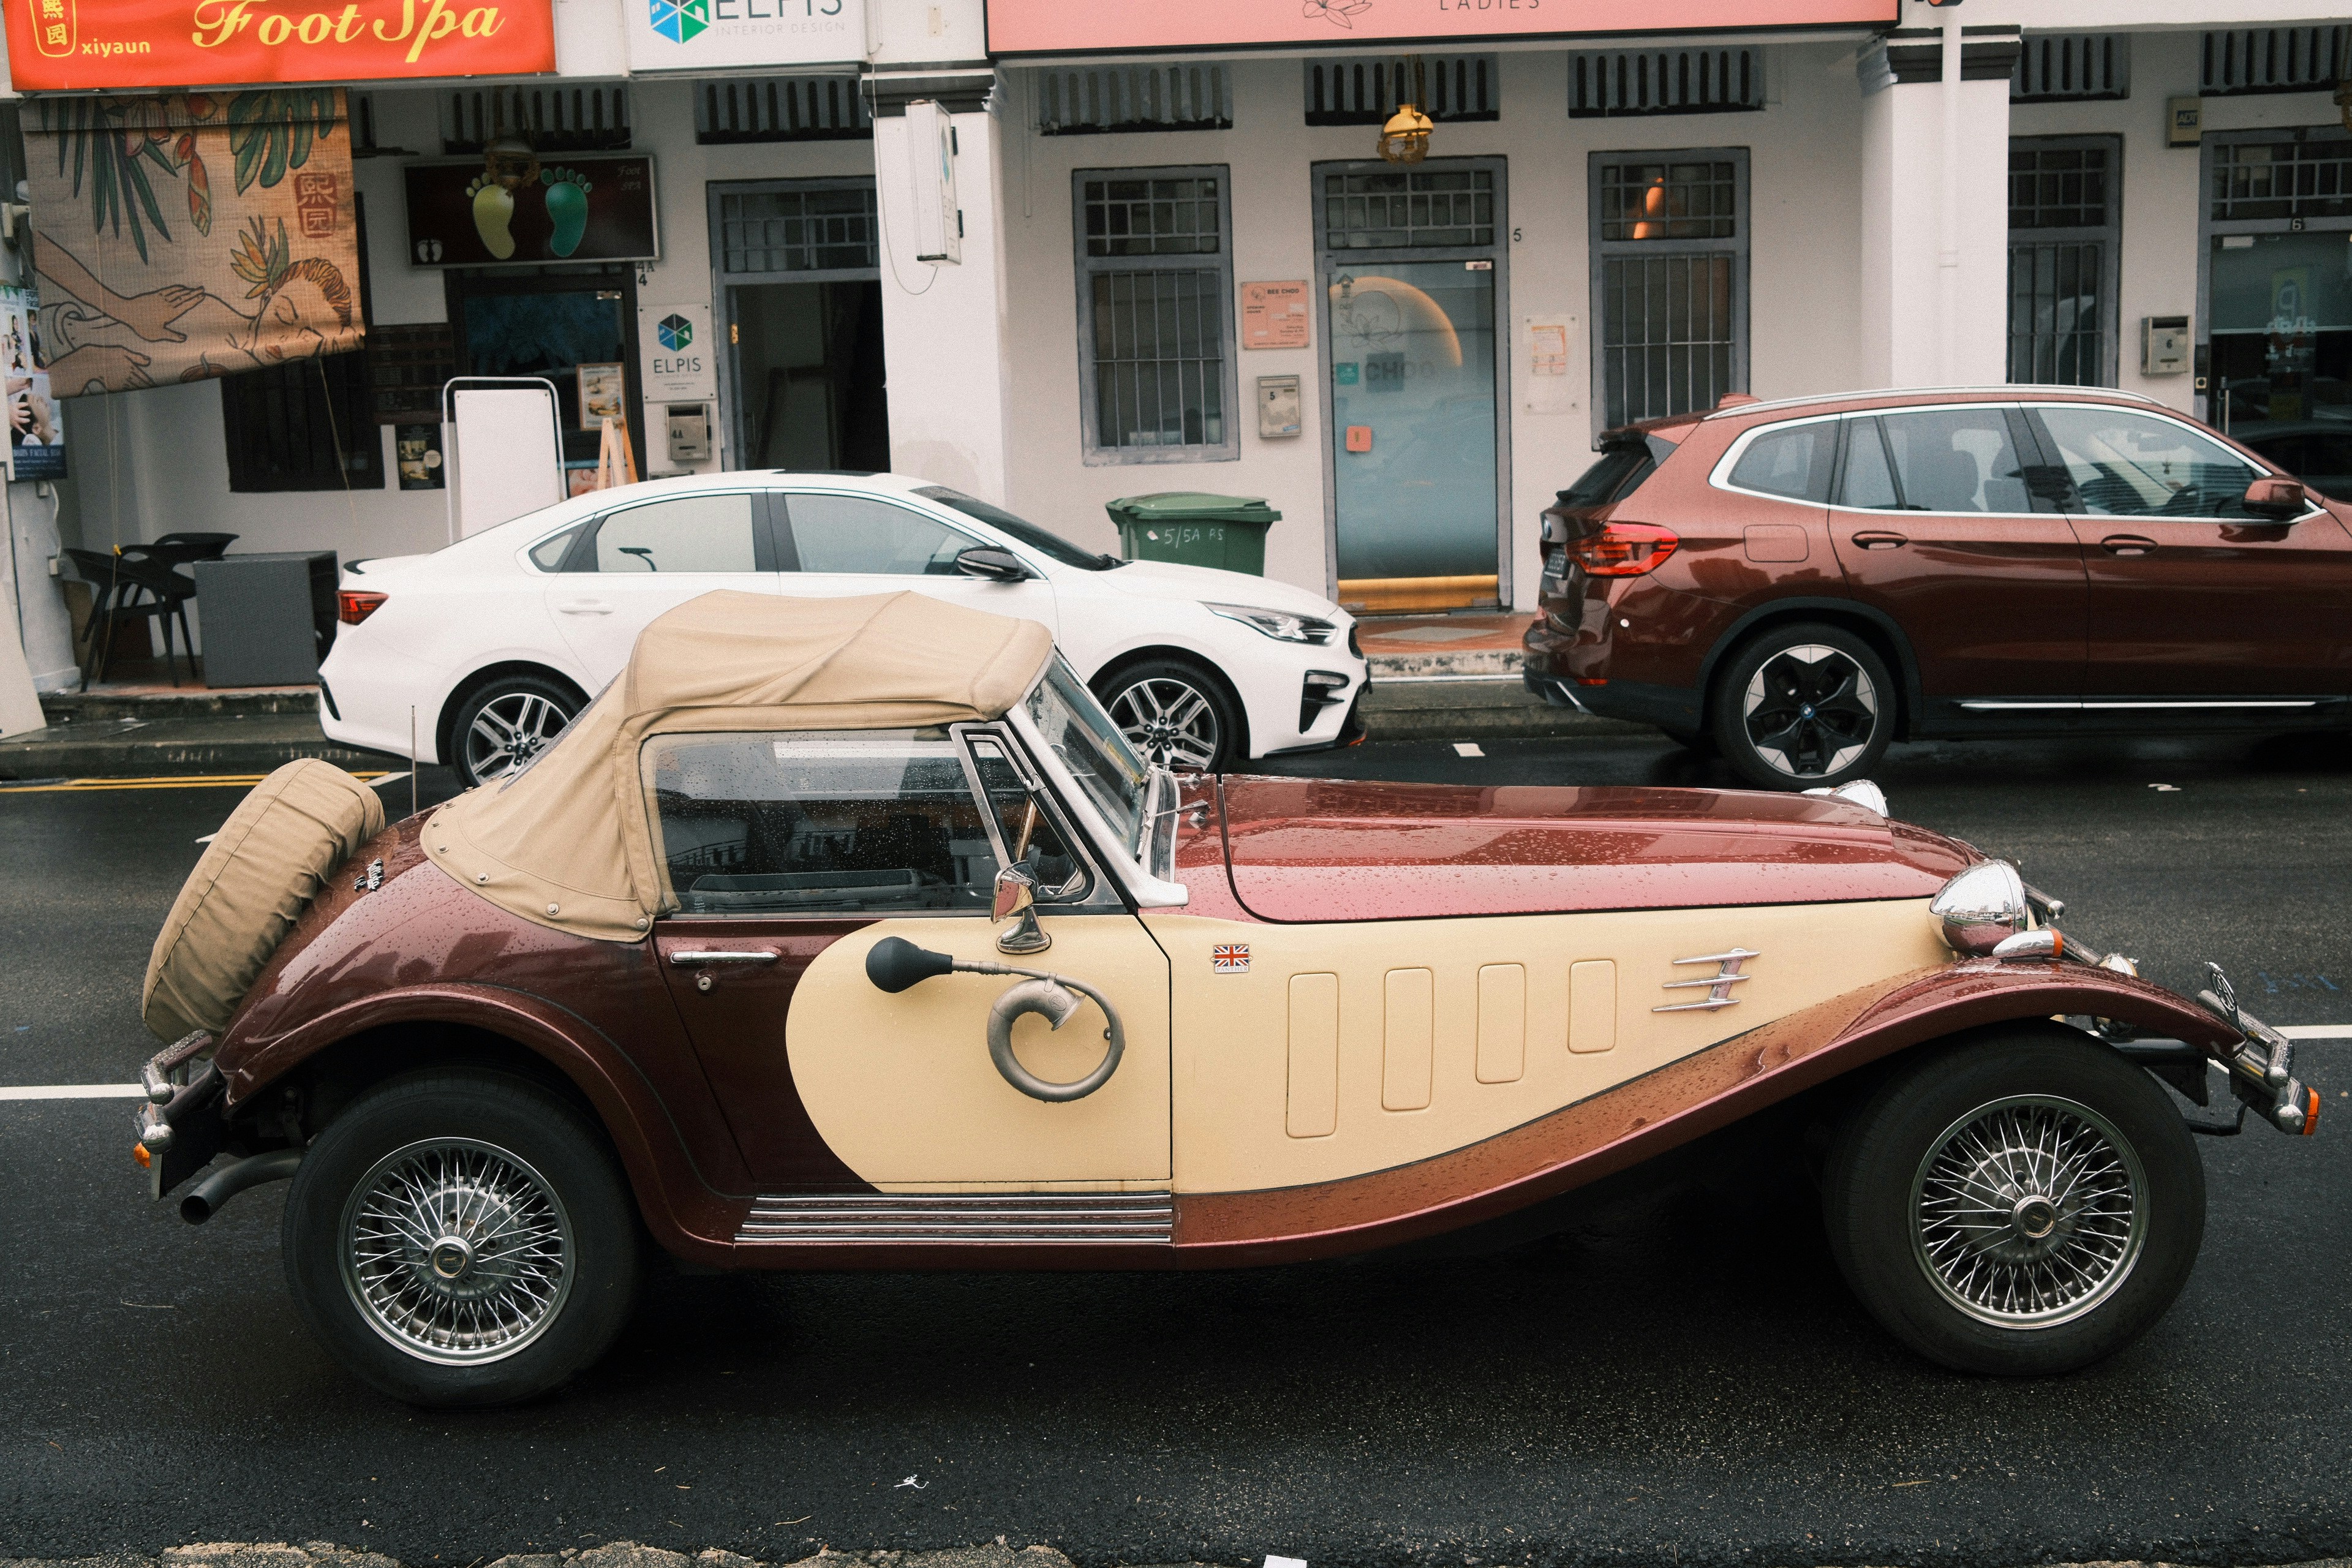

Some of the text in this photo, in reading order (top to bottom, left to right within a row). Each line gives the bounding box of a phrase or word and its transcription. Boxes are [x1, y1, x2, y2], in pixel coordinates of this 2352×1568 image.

[192, 0, 507, 63] Foot Spa
[716, 22, 845, 37] INTERIOR DESIGN
[81, 38, 151, 58] xiyaun
[2291, 218, 2302, 230] 6
[1513, 228, 1522, 243] 5
[638, 273, 647, 287] 4
[654, 357, 702, 373] ELPIS
[1270, 391, 1275, 401] 5
[1164, 526, 1200, 549] 5/5A
